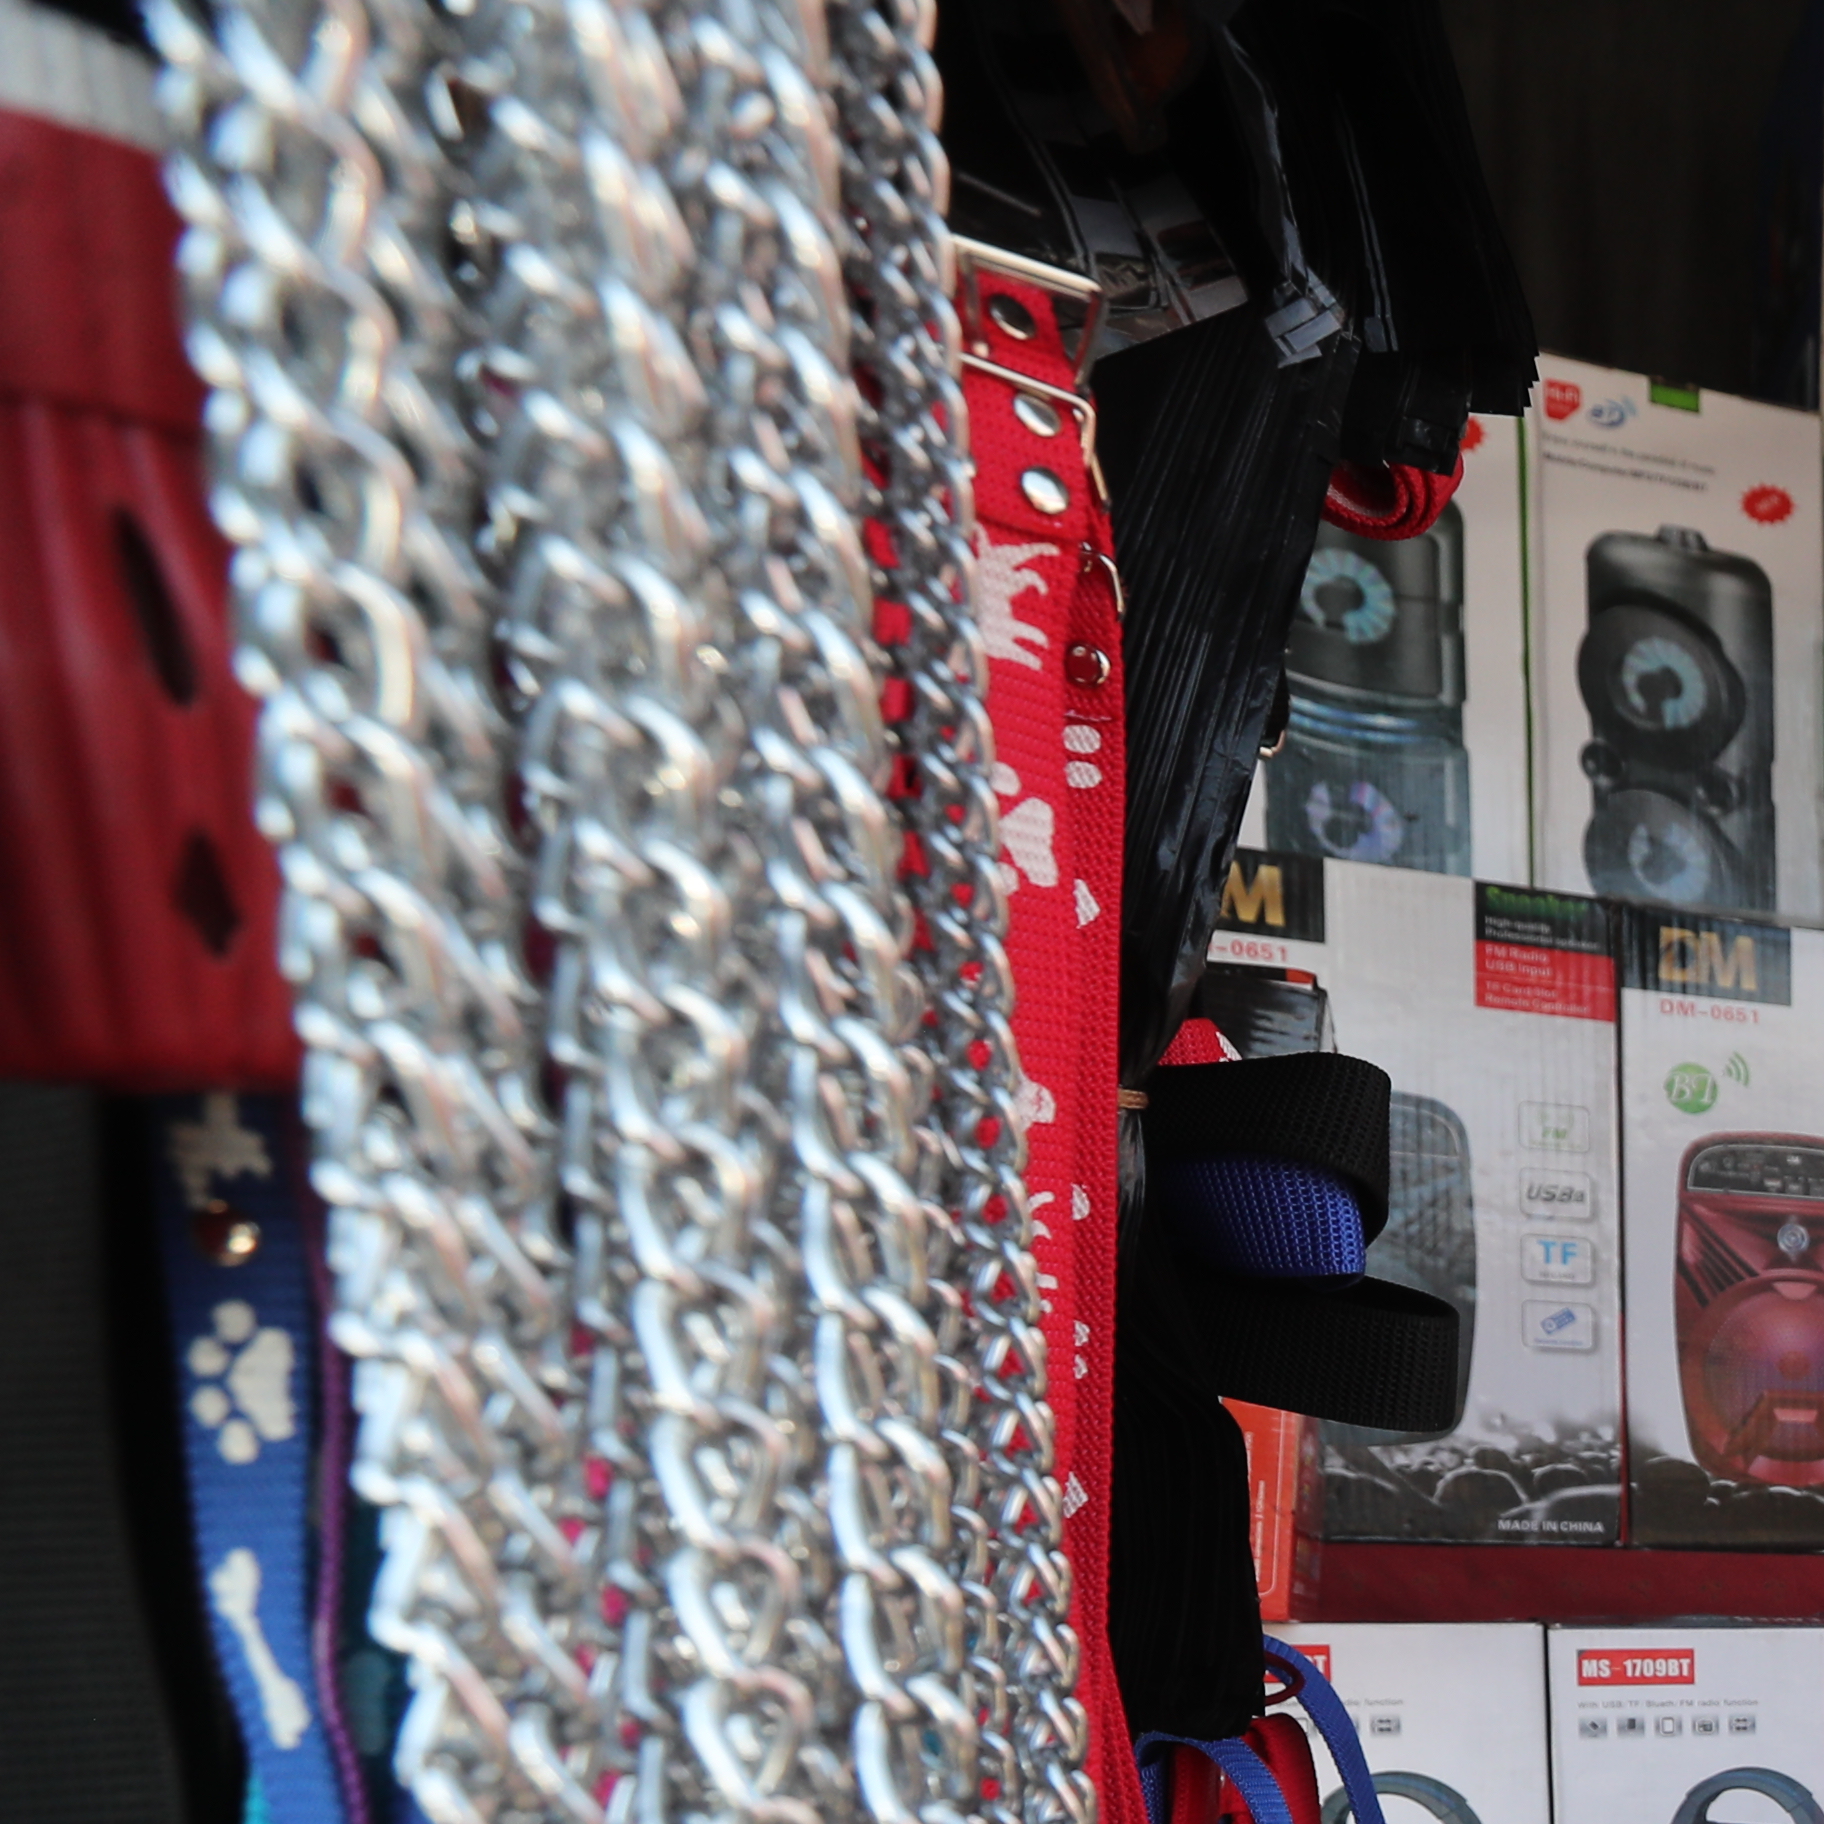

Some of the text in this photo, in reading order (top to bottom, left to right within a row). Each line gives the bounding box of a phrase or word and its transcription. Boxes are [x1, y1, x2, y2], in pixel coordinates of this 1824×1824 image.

[1222, 860, 1286, 927] M
[1485, 943, 1549, 963] FM Radio
[1659, 926, 1758, 991] DM
[1485, 959, 1516, 974] USB
[1660, 998, 1760, 1024] DM-0651
[1538, 1240, 1577, 1265] TF
[1498, 1520, 1605, 1535] MADE IN CHINA
